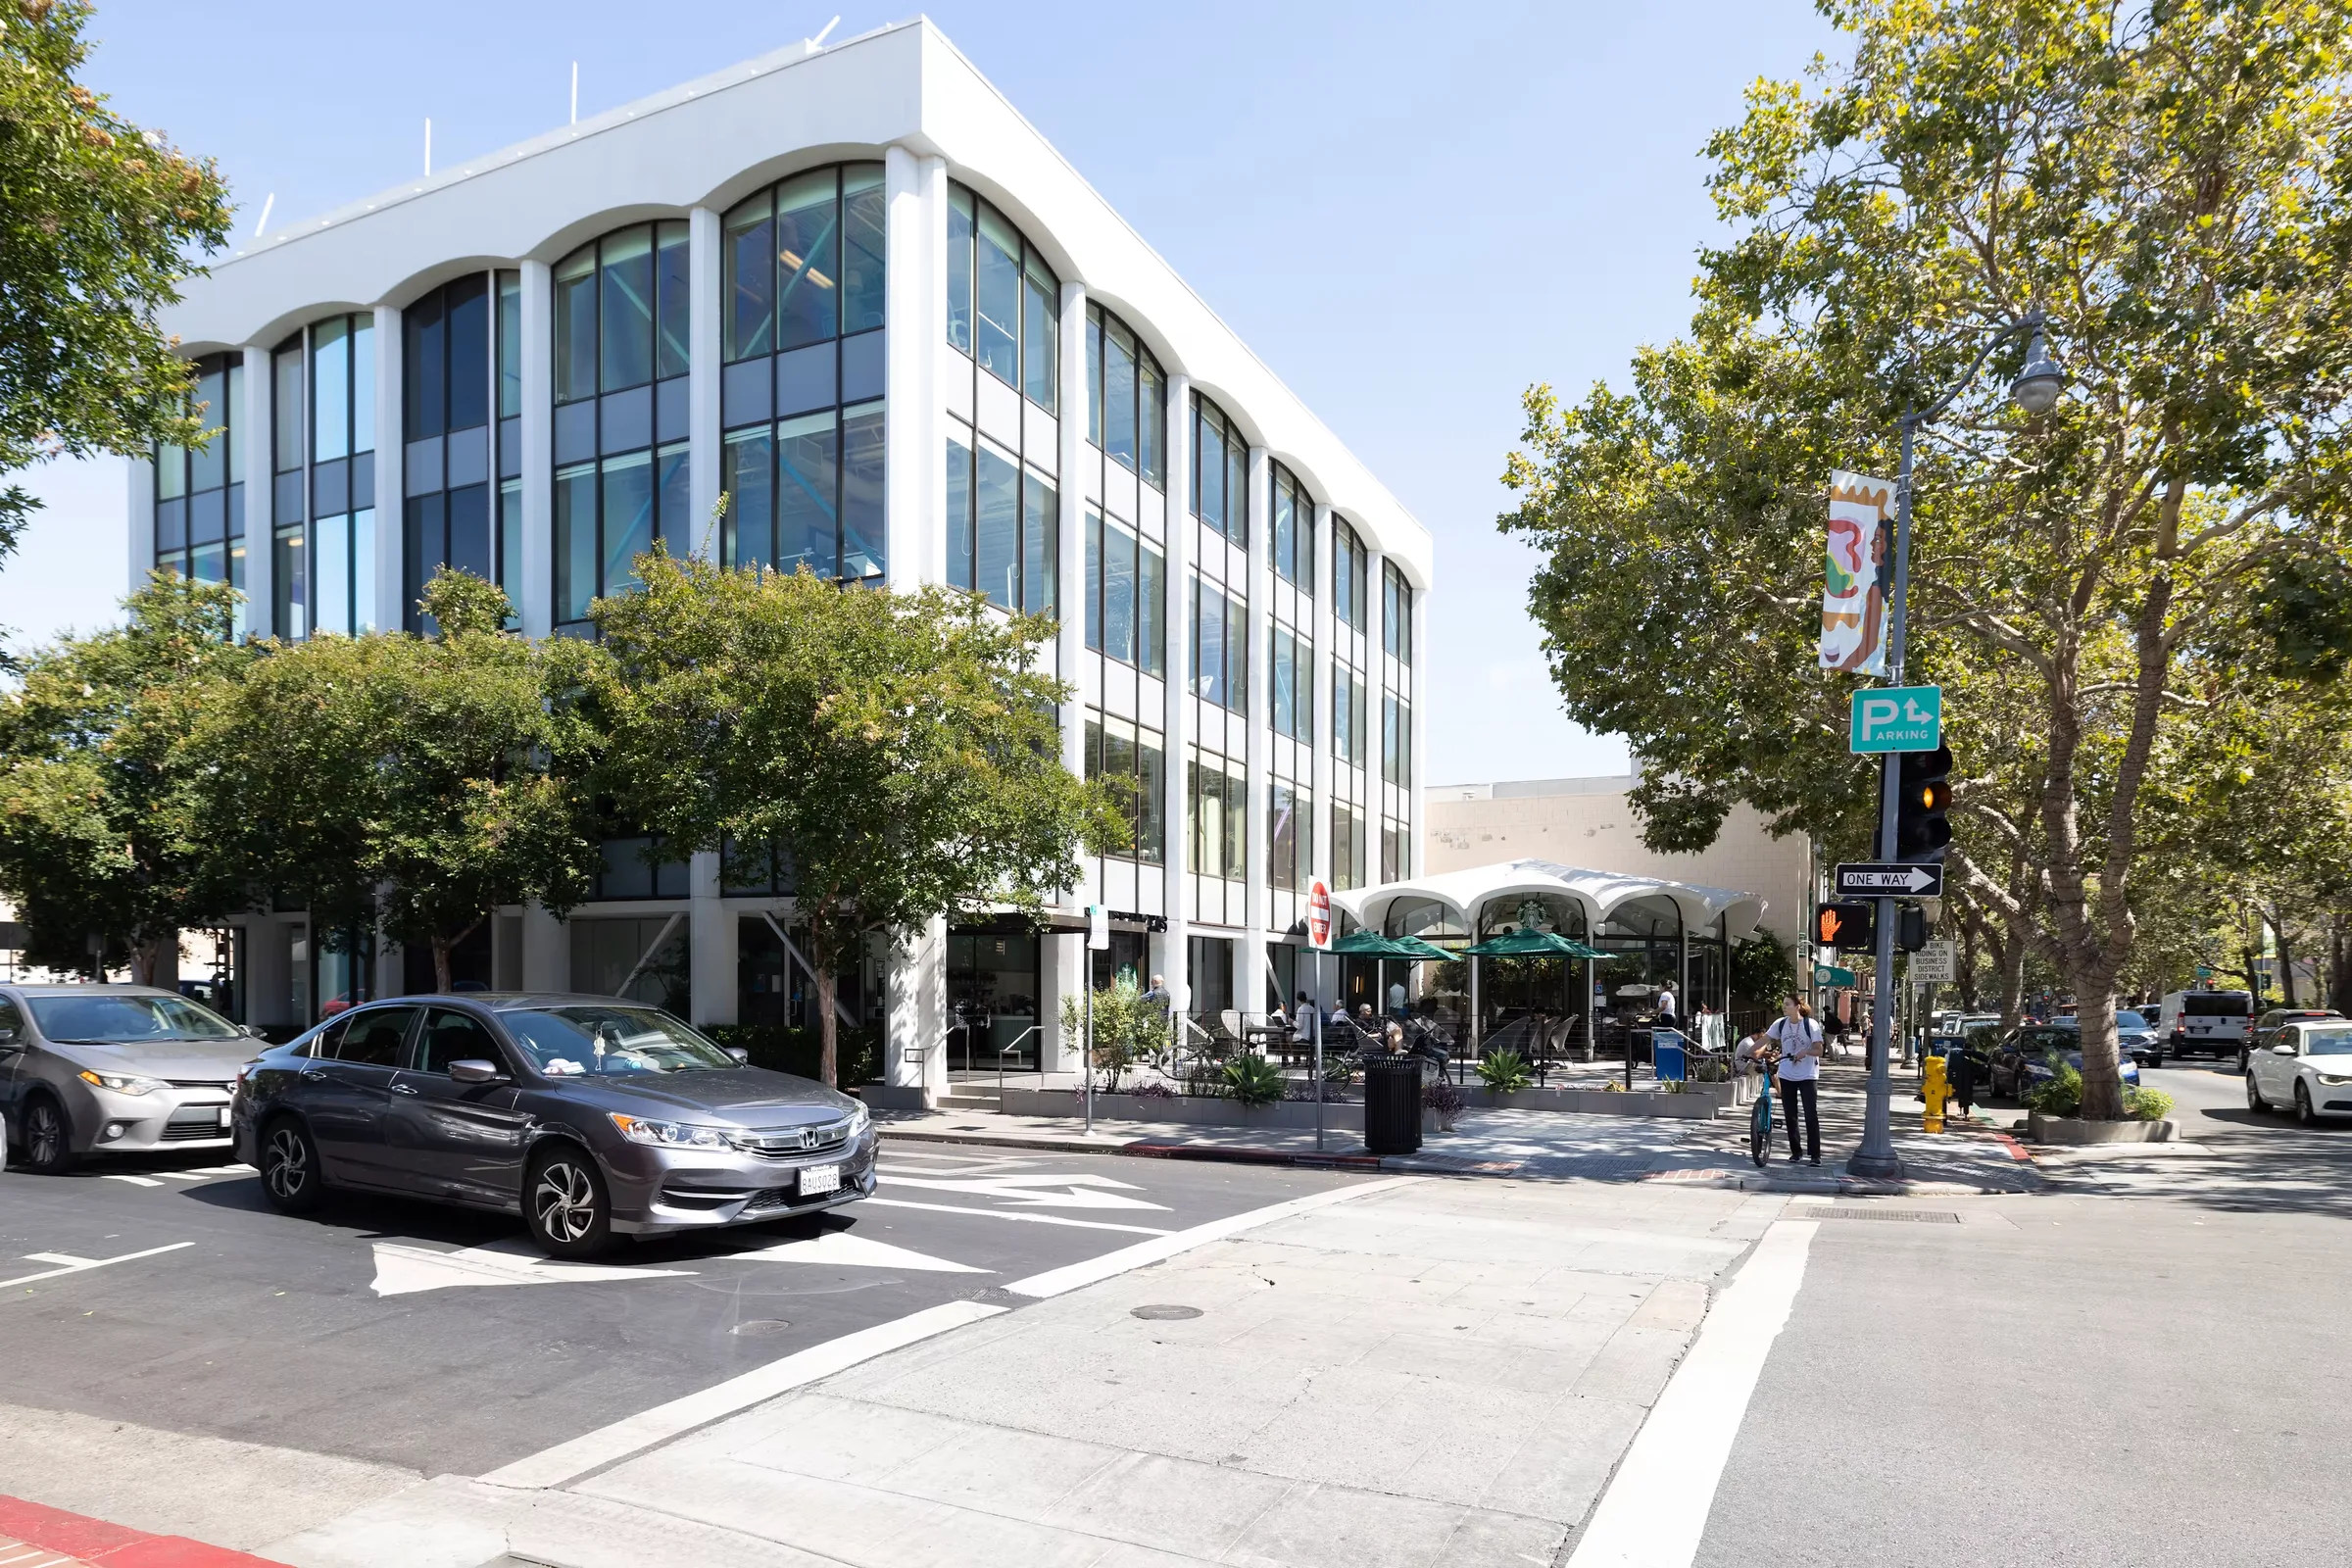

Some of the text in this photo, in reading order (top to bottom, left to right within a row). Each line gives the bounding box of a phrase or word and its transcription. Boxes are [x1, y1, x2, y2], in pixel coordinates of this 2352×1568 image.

[1862, 699, 1929, 742] PARKING
[1846, 874, 1909, 885] ONE WAY
[1312, 893, 1318, 904] DO
[1313, 922, 1327, 935] ENTER
